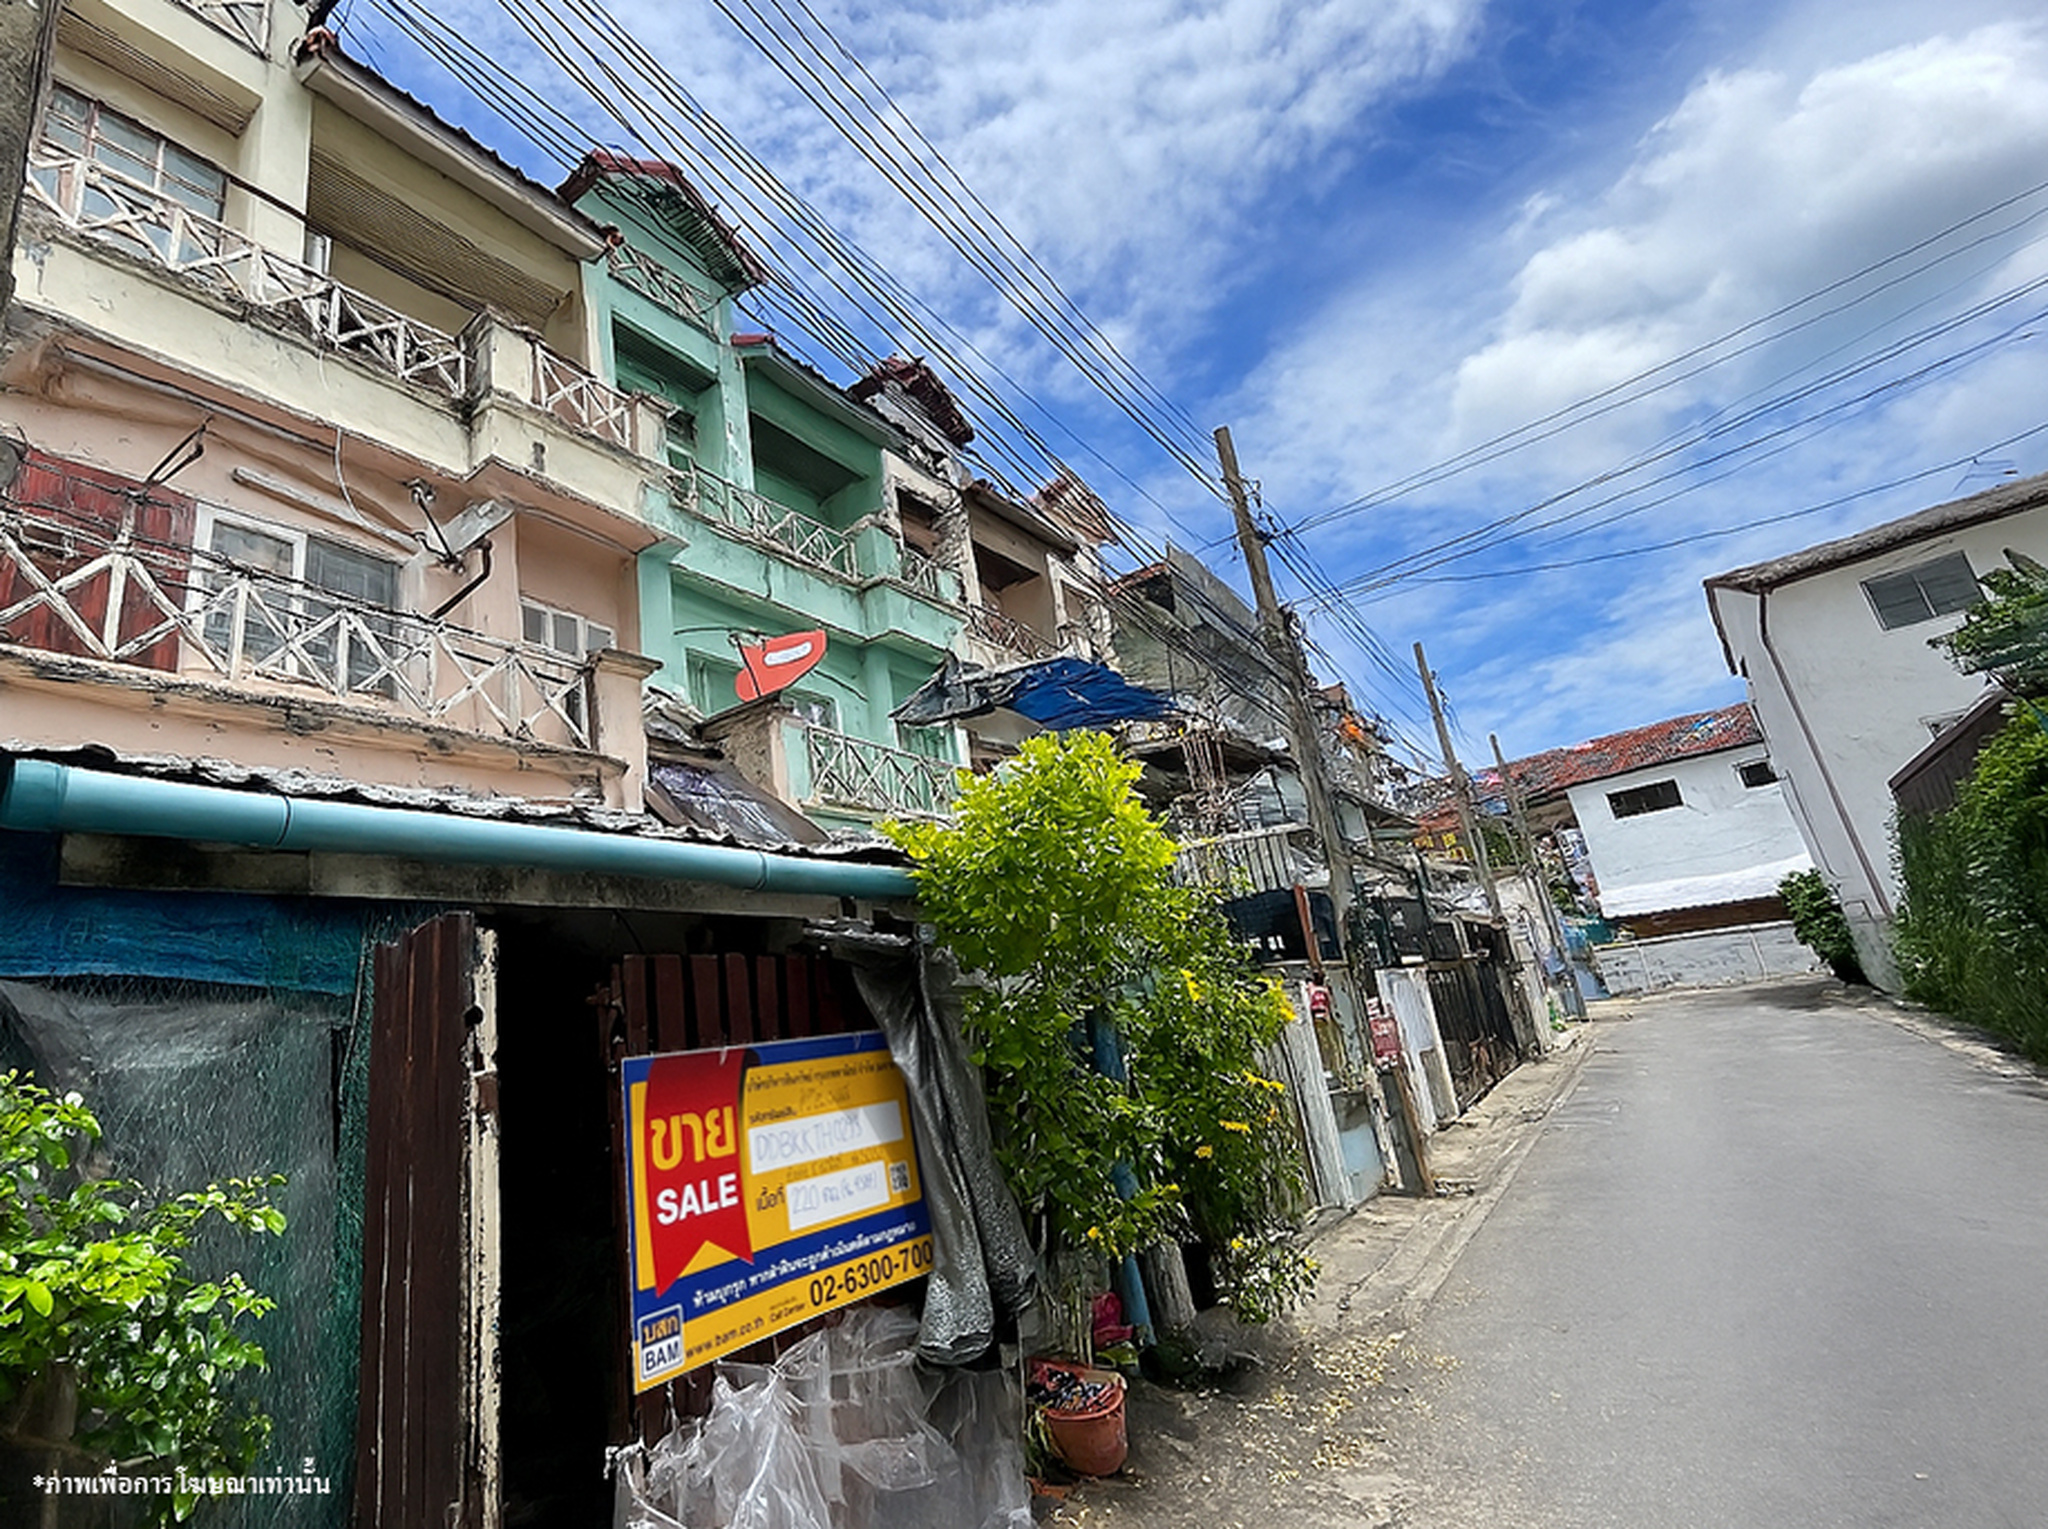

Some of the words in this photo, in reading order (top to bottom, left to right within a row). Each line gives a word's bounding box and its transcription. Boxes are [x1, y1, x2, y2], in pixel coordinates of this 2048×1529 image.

[650, 1106, 736, 1171] ขาย
[656, 1173, 739, 1225] SALE
[809, 1240, 934, 1307] 02-6300-700
[645, 1341, 680, 1371] BAM
